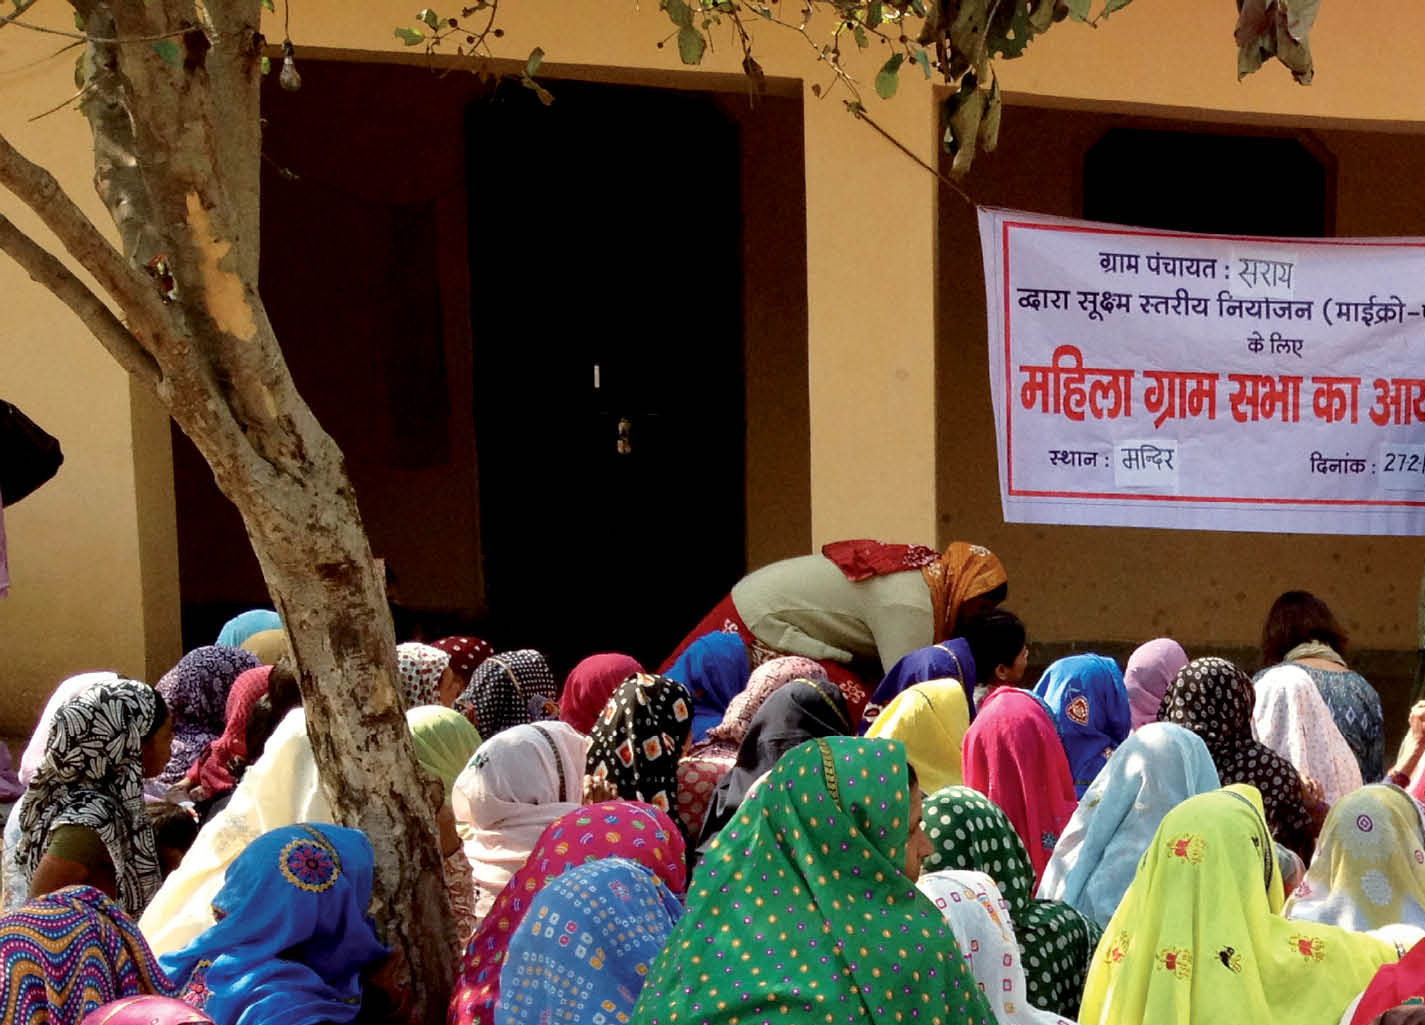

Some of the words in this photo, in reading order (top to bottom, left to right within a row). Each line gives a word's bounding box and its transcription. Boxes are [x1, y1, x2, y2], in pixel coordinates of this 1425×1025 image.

[1099, 251, 1140, 275] ग्राम
[1077, 290, 1132, 322] सूक्ष्म
[1139, 287, 1210, 317] स्तरीय
[1247, 331, 1265, 353] के
[1270, 332, 1304, 358] लिए
[1019, 344, 1136, 422] महिला
[1143, 370, 1220, 430] ग्राम
[1228, 372, 1304, 424] सभा
[1311, 375, 1362, 425] का
[1049, 449, 1099, 468] स्थान
[1120, 444, 1175, 471] मन्दिर
[1310, 450, 1367, 475] दिनांक
